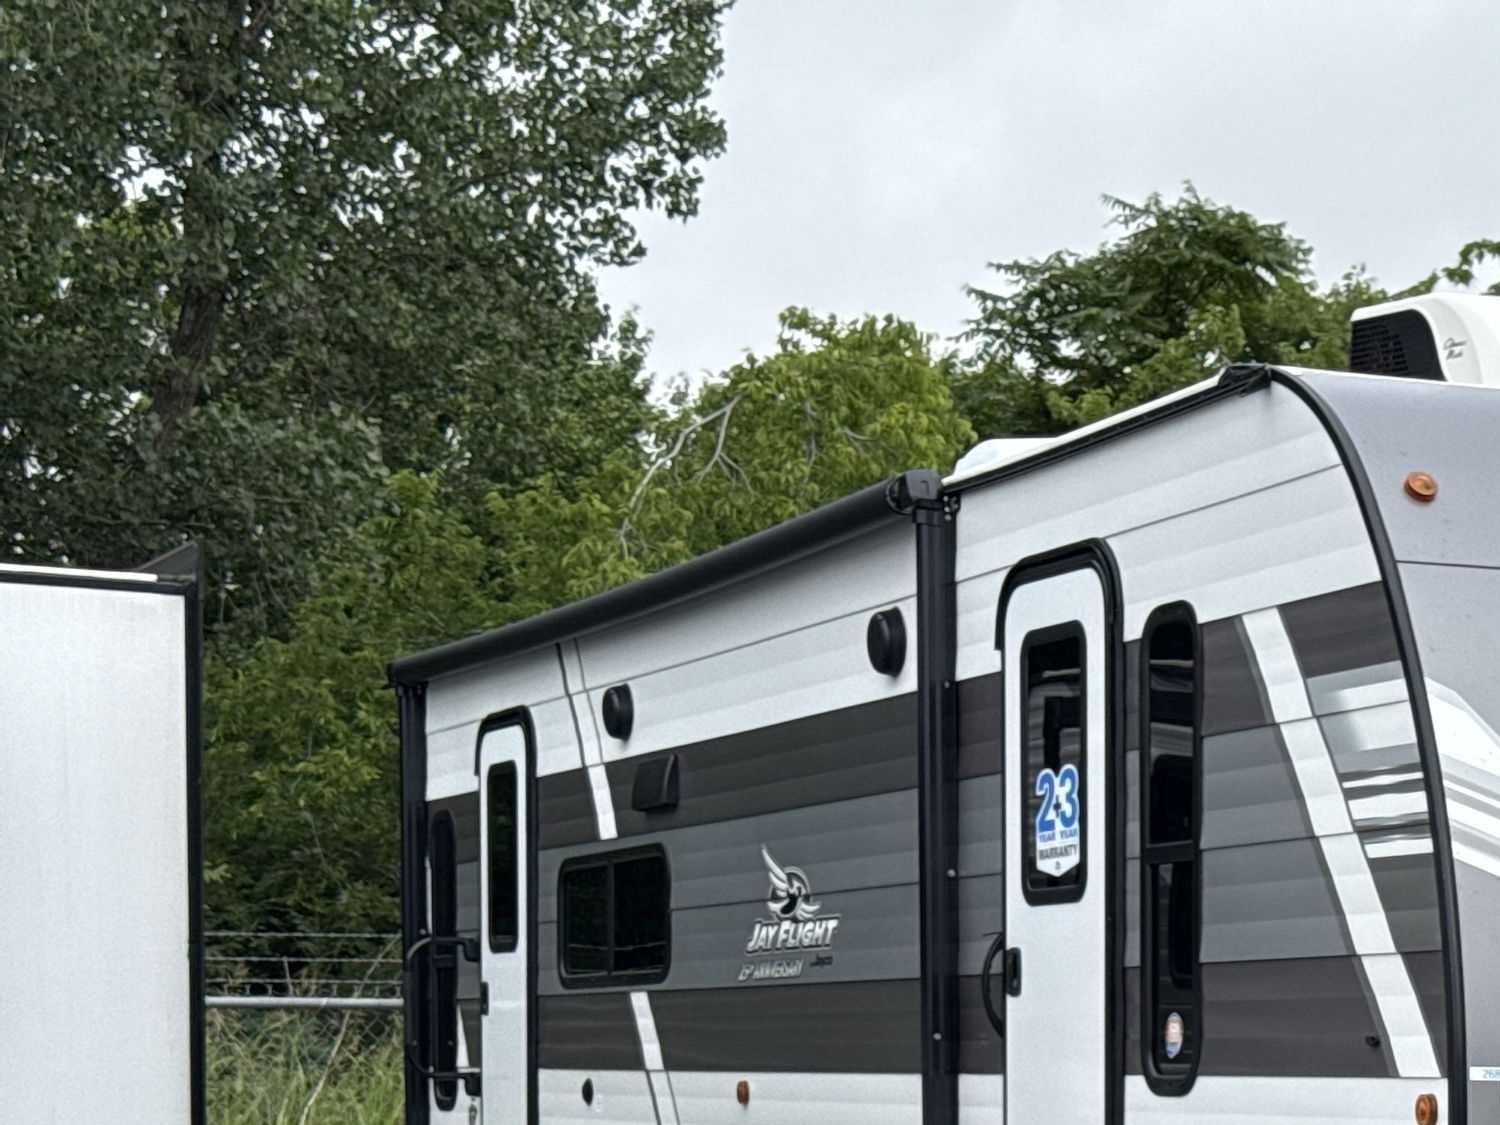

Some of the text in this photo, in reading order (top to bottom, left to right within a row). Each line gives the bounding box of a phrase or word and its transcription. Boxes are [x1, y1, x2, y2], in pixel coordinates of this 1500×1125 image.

[1038, 844, 1078, 861] WARRANTY
[746, 918, 839, 953] JAY FLIGHT
